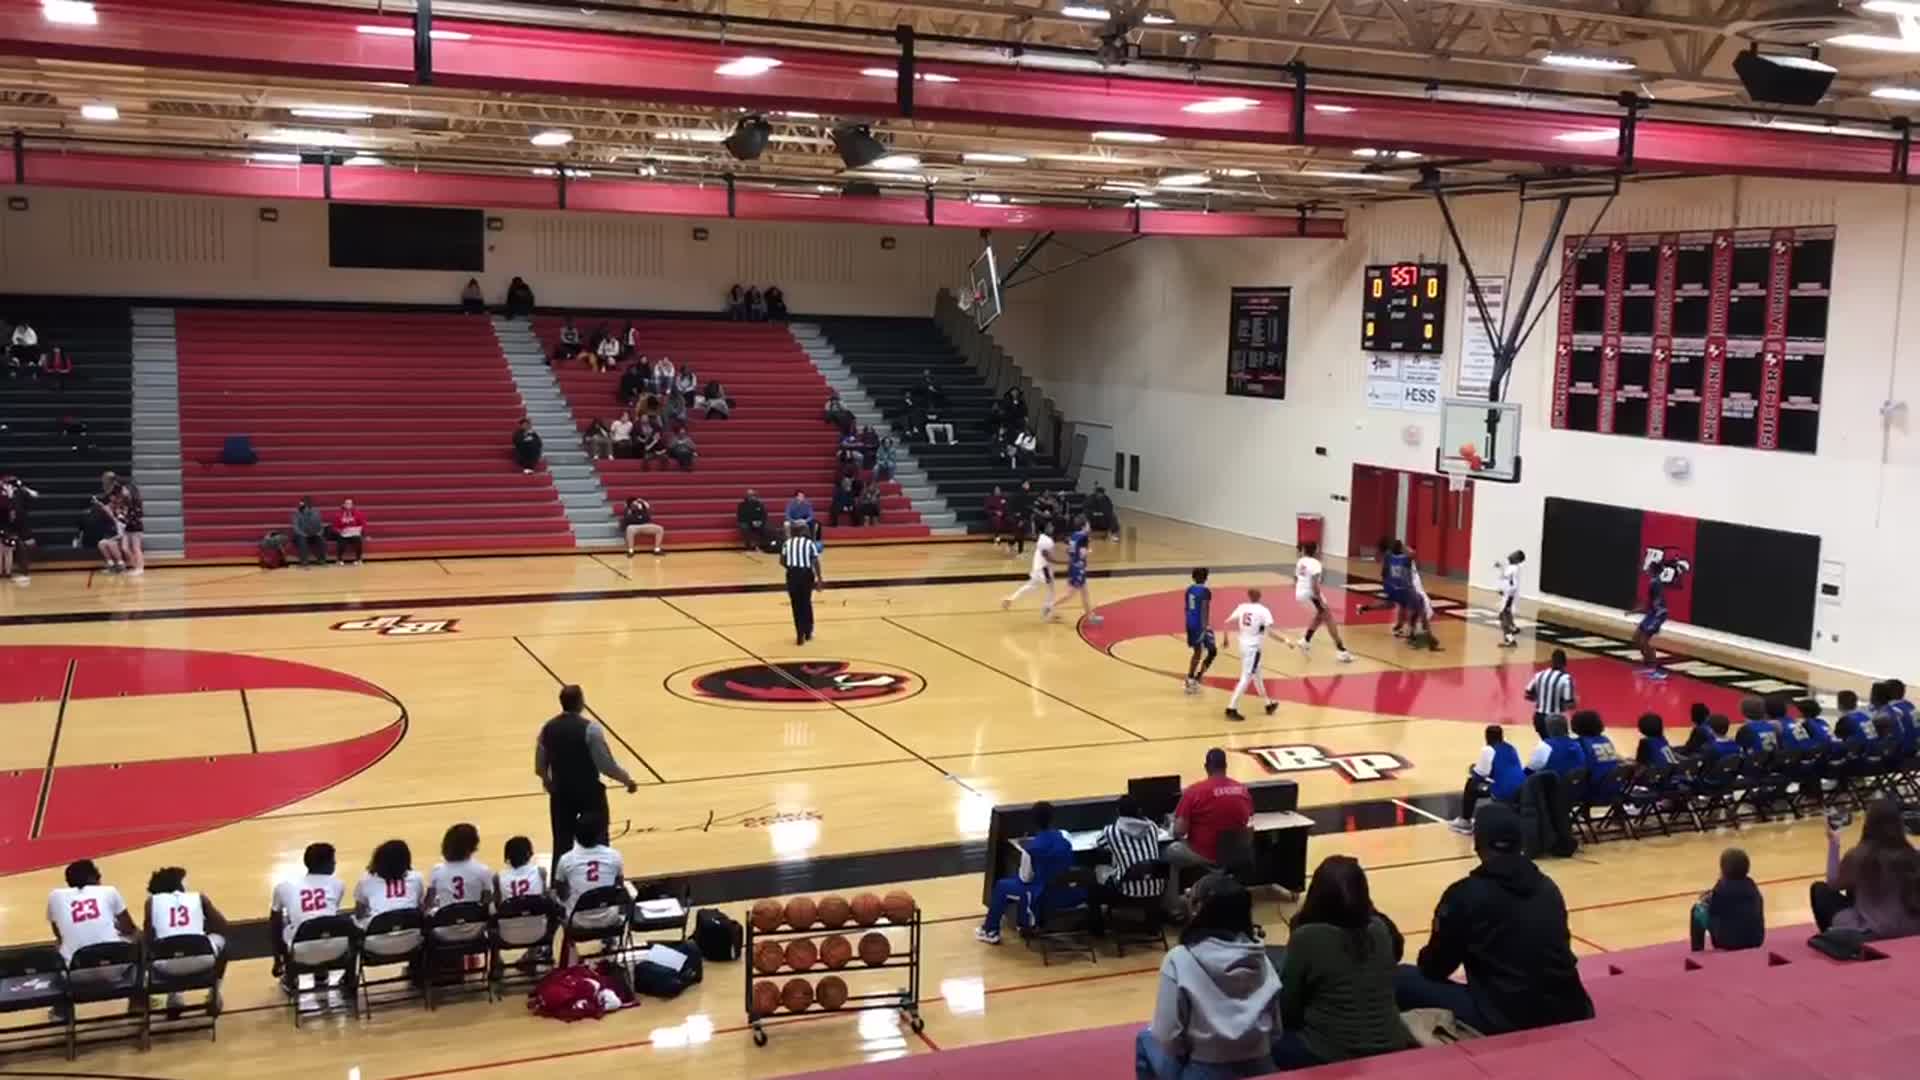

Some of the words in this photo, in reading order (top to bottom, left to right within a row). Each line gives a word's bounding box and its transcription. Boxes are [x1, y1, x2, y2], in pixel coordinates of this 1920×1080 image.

[1373, 277, 1383, 298] 0
[1427, 277, 1438, 298] 0
[1404, 387, 1437, 404] HESS
[1760, 368, 1780, 449] SOCCER
[1247, 744, 1407, 782] BP
[586, 860, 600, 882] 2
[451, 875, 465, 900] 3
[509, 879, 531, 896] 12
[70, 898, 101, 923] 23
[299, 888, 327, 912] 22
[168, 905, 190, 928] 13
